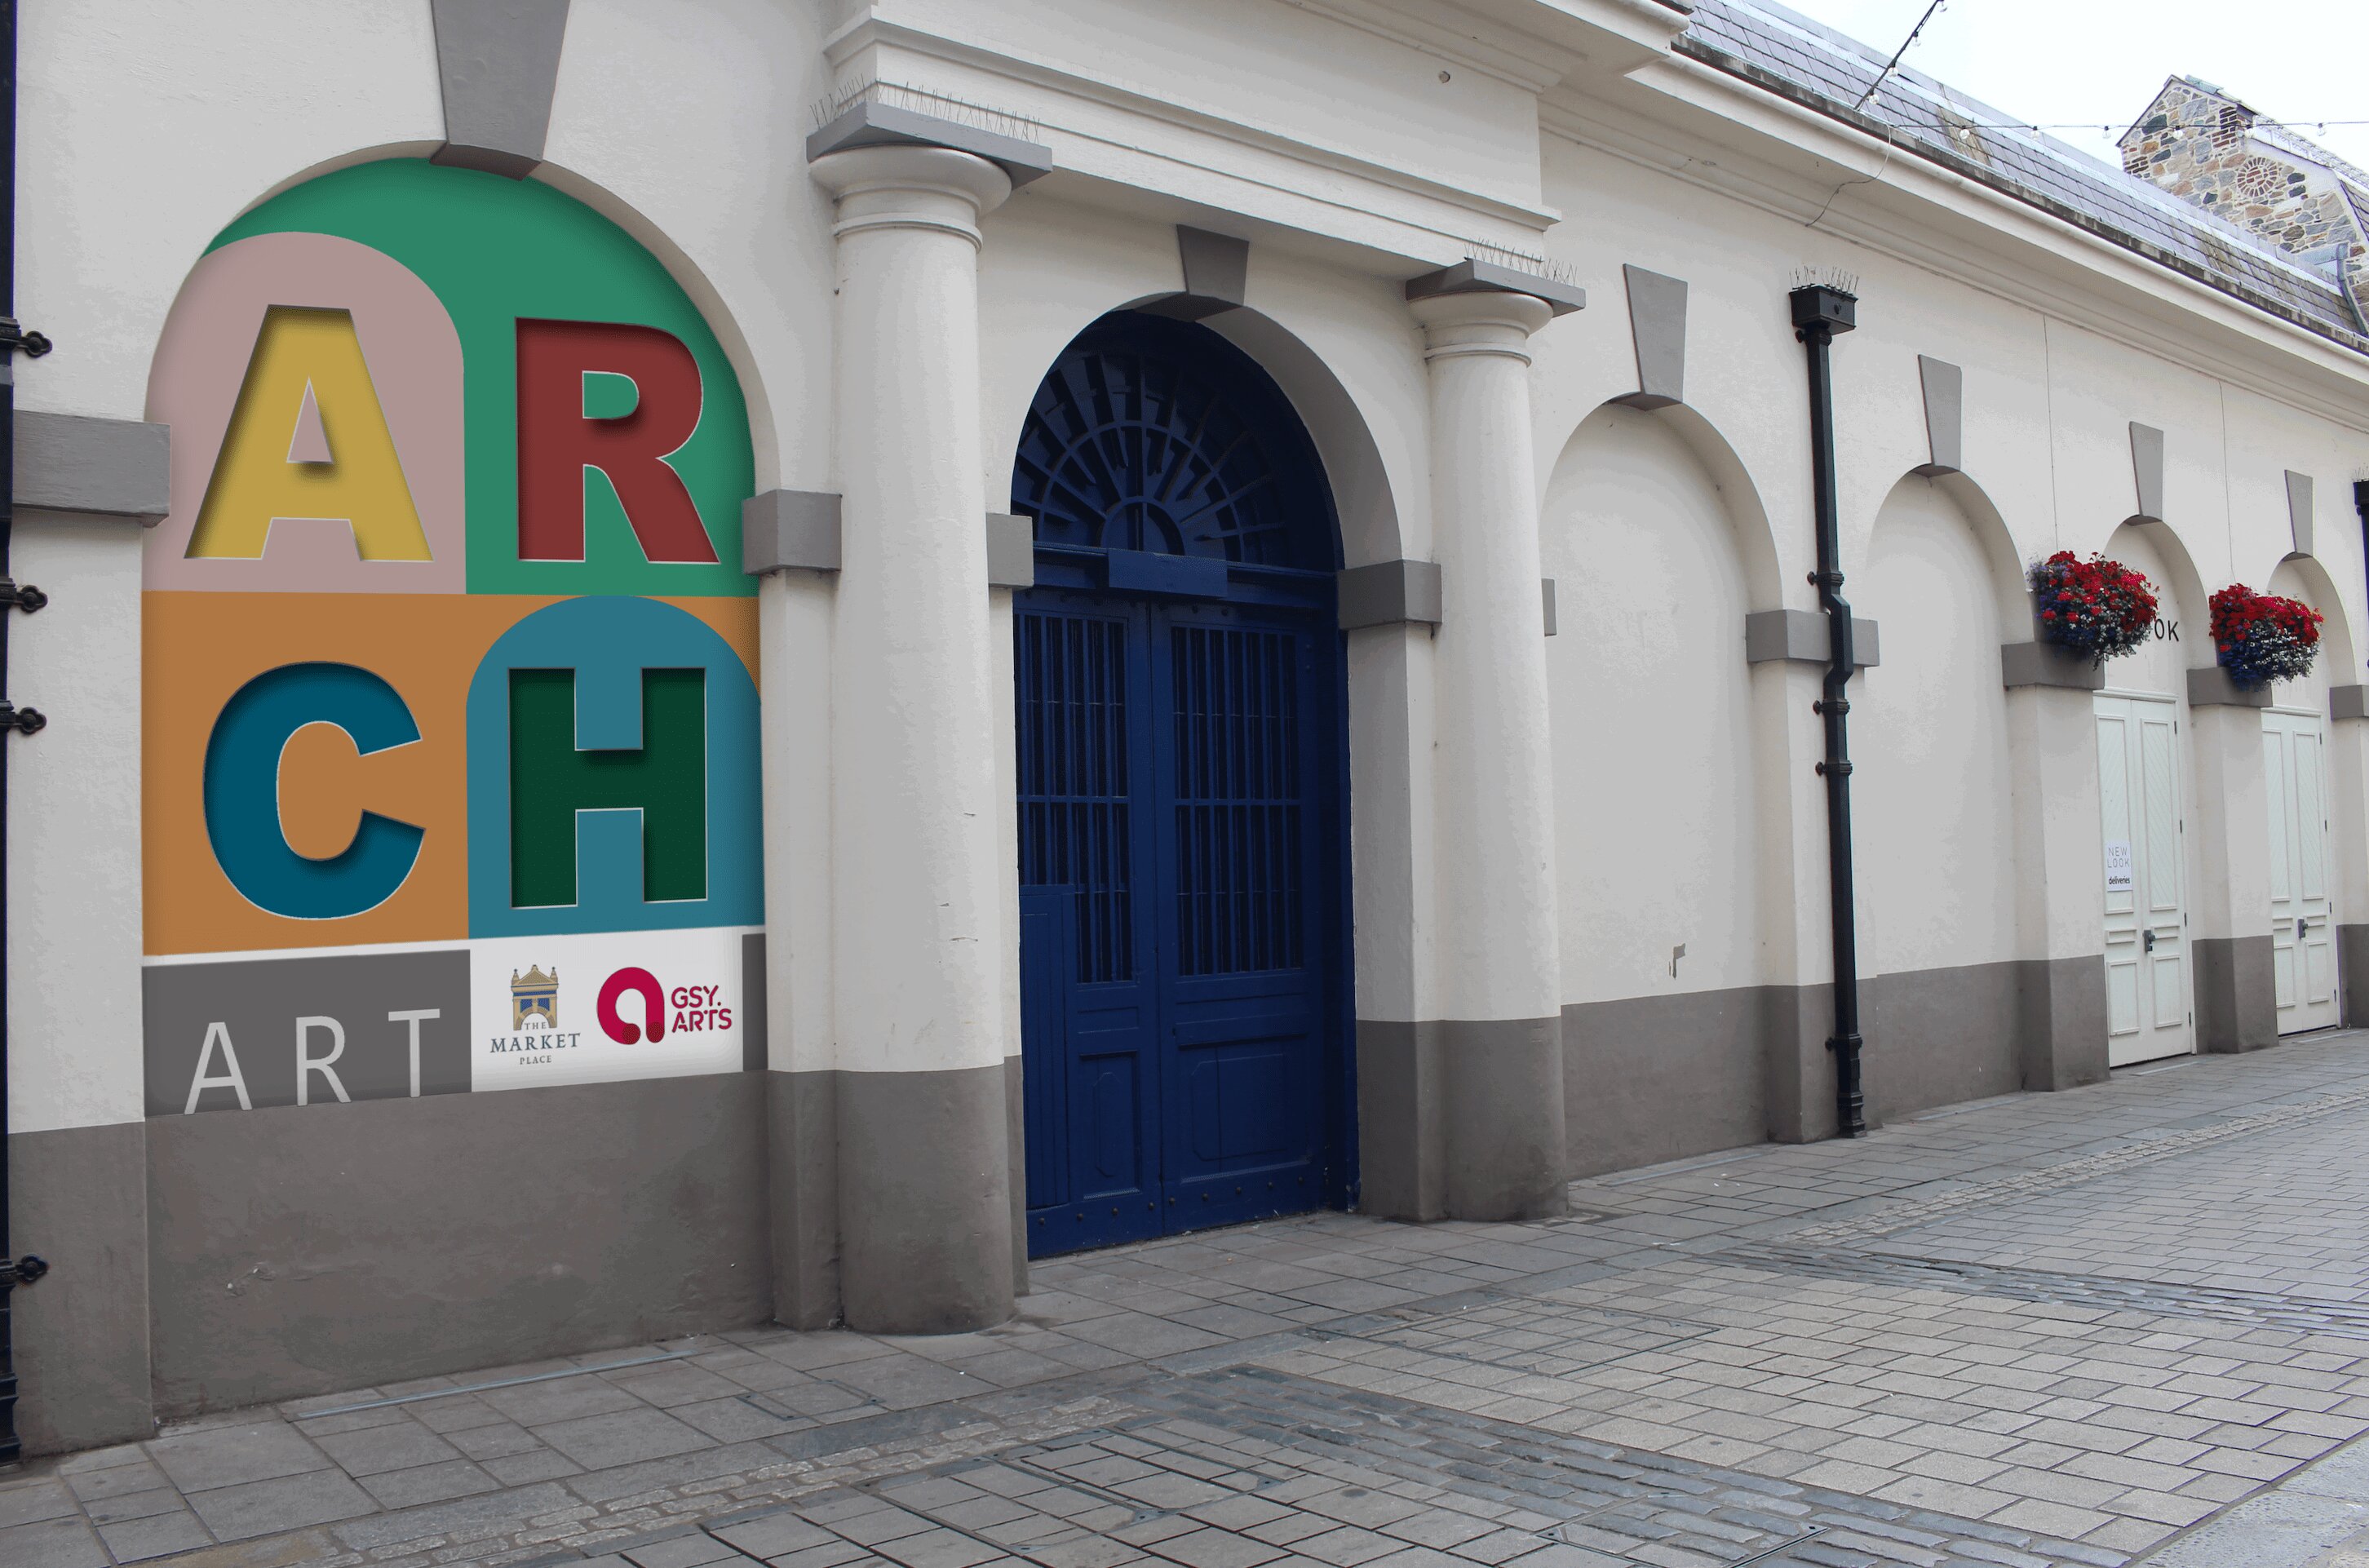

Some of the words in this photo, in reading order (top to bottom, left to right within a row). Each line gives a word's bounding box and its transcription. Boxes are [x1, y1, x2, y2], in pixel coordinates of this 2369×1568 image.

[2154, 618, 2179, 642] OK
[2108, 846, 2128, 857] NEW
[2107, 857, 2130, 869] LOOK
[2108, 875, 2131, 885] deliveries
[671, 985, 721, 1008] GSY.
[524, 1021, 547, 1030] THE
[671, 1008, 732, 1033] ARTS
[489, 1032, 581, 1053] MARKET
[184, 1008, 441, 1115] ART
[519, 1055, 553, 1065] PLACE
